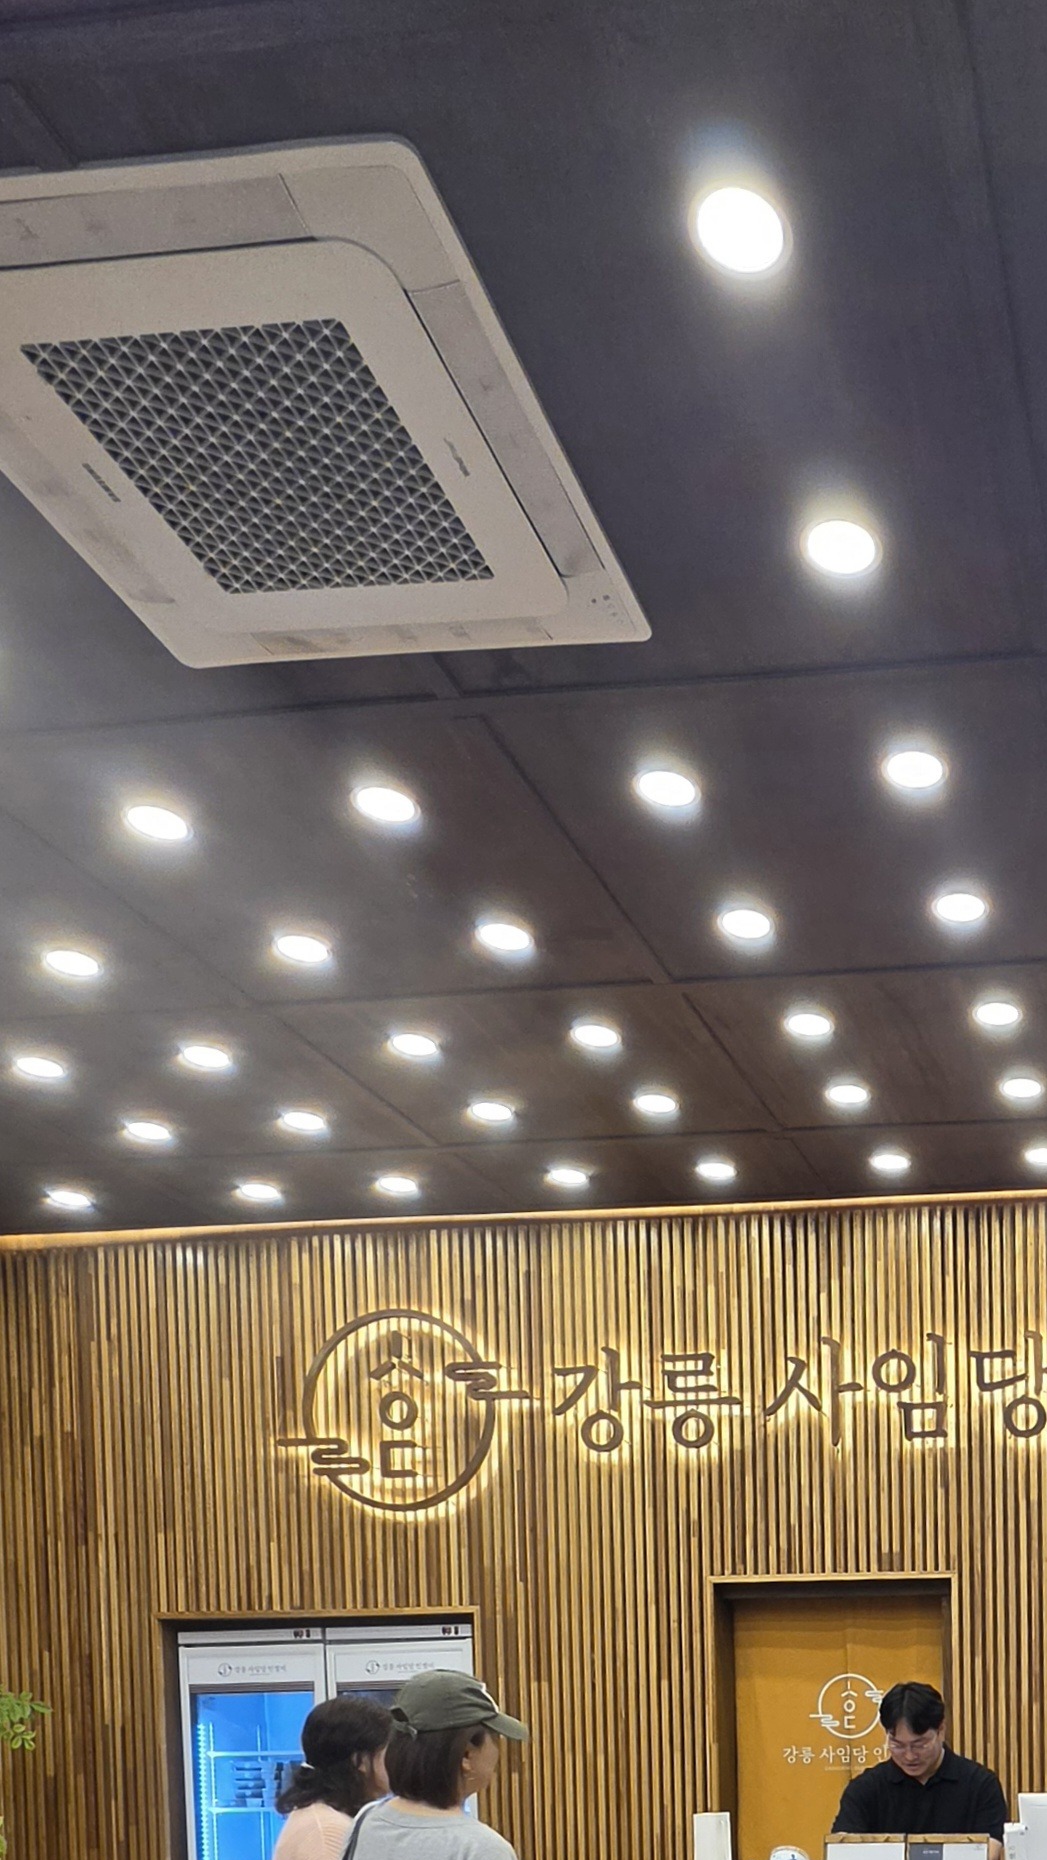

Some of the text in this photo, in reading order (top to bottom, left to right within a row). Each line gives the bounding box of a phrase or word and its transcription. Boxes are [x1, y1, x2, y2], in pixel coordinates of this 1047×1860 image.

[552, 1345, 743, 1453] 강릉
[782, 1745, 816, 1764] 강릉
[819, 1745, 869, 1764] 사임당
